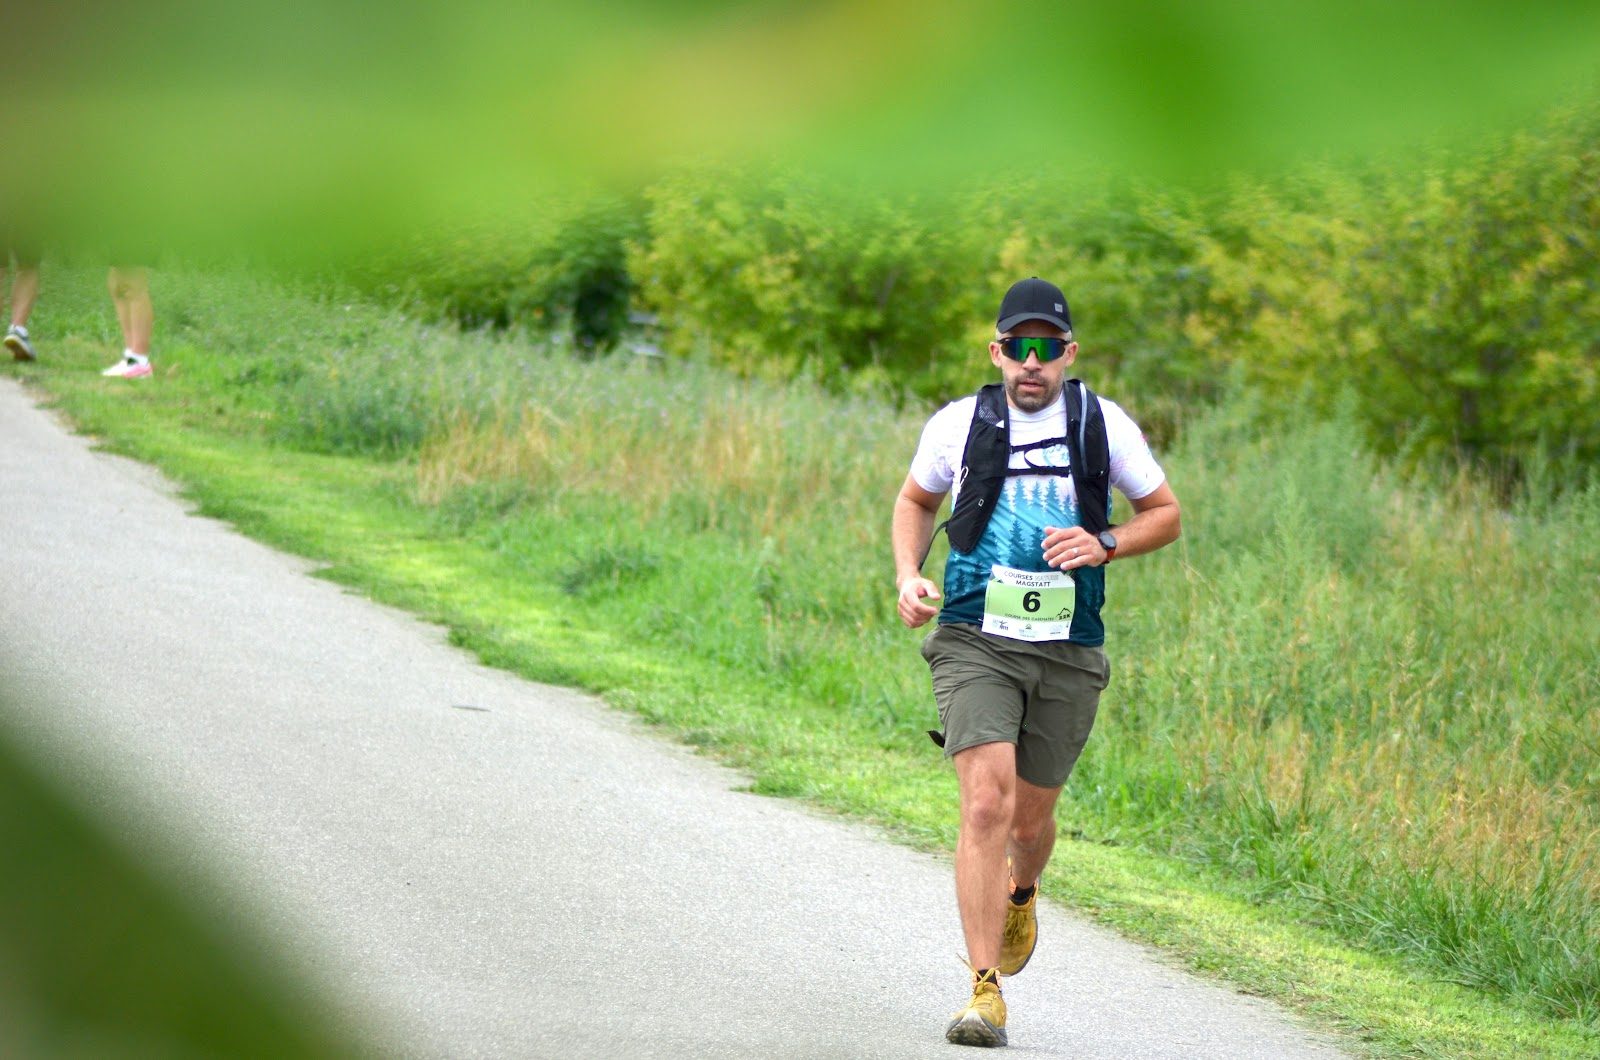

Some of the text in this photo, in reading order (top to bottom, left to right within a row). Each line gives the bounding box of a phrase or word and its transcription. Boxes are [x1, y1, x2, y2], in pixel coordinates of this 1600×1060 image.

[1003, 571, 1033, 581] COURSES
[1015, 580, 1051, 588] MAGSTATT
[1022, 591, 1041, 613] 6
